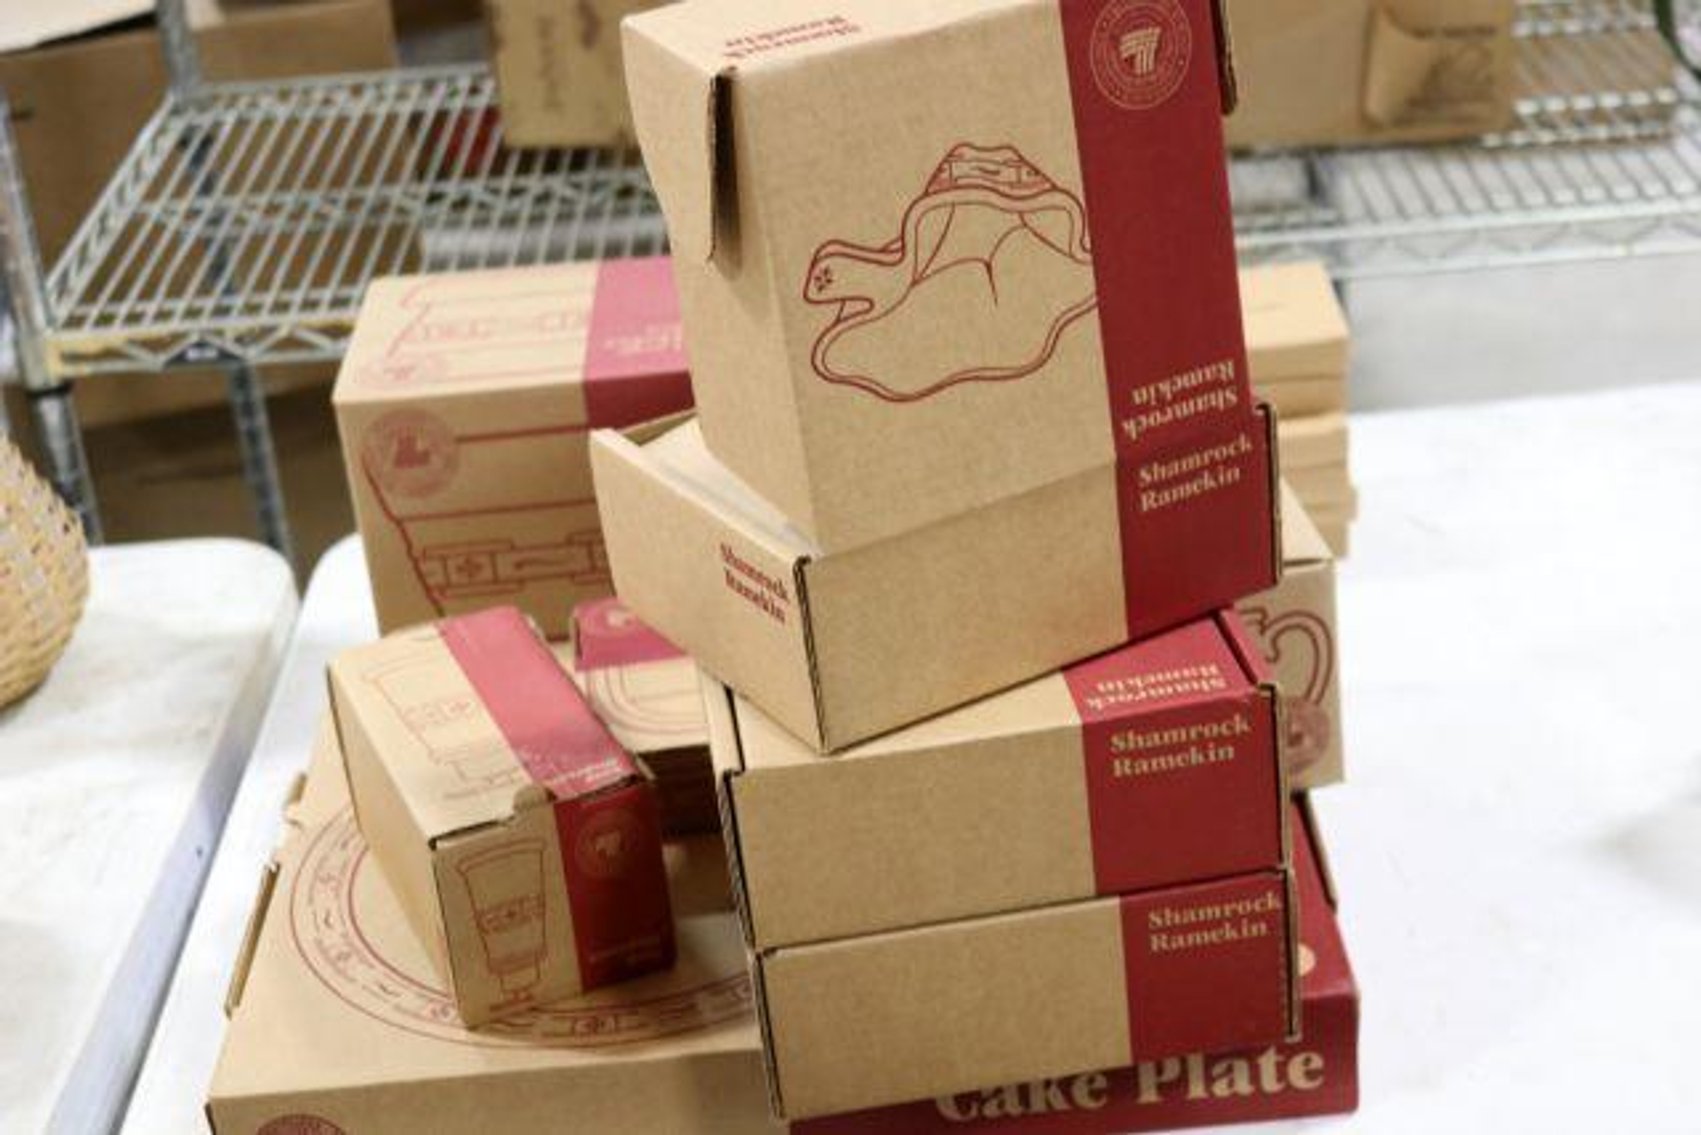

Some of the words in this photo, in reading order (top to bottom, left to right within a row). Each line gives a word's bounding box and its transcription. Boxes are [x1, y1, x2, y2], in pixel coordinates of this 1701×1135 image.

[1132, 359, 1236, 406] Ramekin
[1121, 386, 1239, 441] Shamrock
[1138, 433, 1253, 489] Shamrock
[1140, 466, 1242, 513] Ramekin
[720, 541, 791, 605] Shamrock
[1086, 676, 1227, 711] Shamrock
[1097, 663, 1220, 694] Ramekin
[1109, 712, 1252, 754] Shamrock
[1112, 741, 1235, 778] Ramekin
[1147, 891, 1284, 930] Shamrock
[1149, 918, 1268, 953] Ramekin
[1136, 1045, 1326, 1105] Plate
